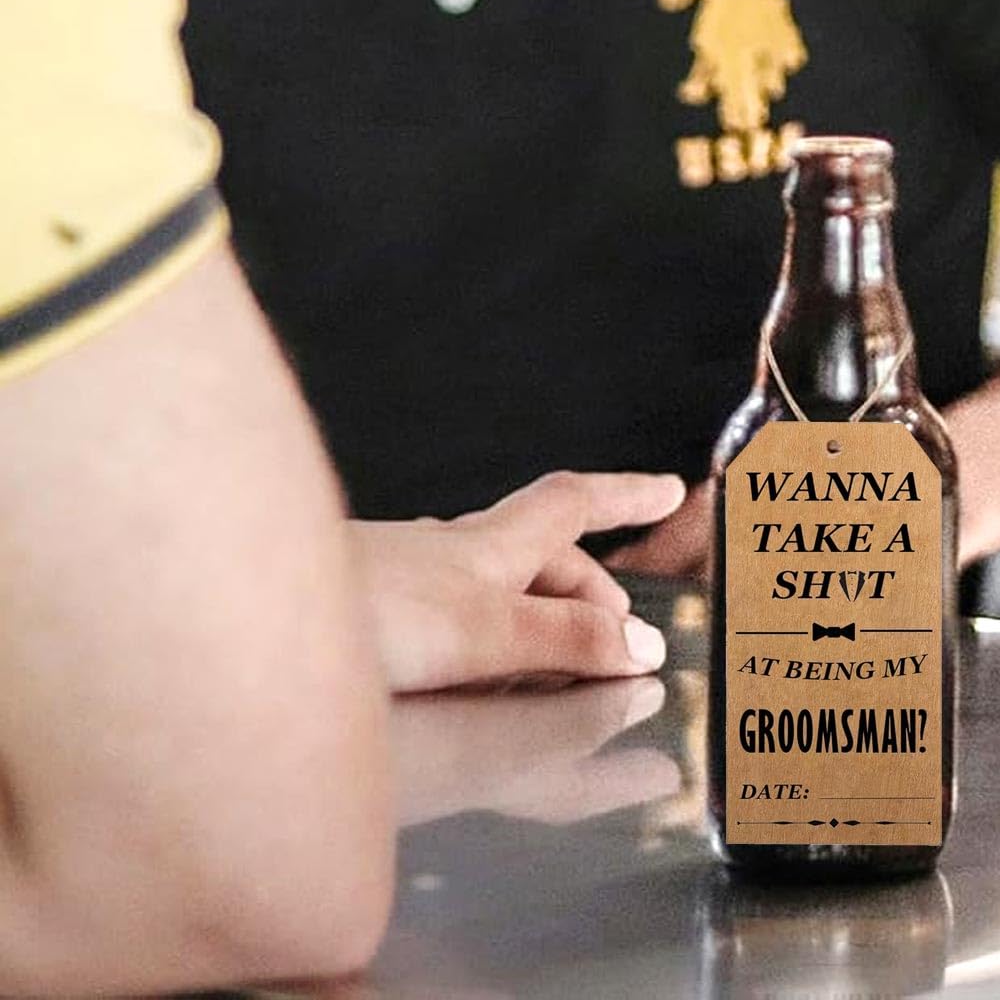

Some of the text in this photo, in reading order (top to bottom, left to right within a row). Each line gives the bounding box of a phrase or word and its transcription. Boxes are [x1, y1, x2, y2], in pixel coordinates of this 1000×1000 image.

[745, 471, 921, 502] WANNA
[752, 523, 916, 553] TAKE A
[771, 570, 896, 602] SHT
[736, 653, 929, 681] AT BEING MY
[739, 708, 928, 754] GROOMSMAN?
[739, 783, 810, 800] DATE:
